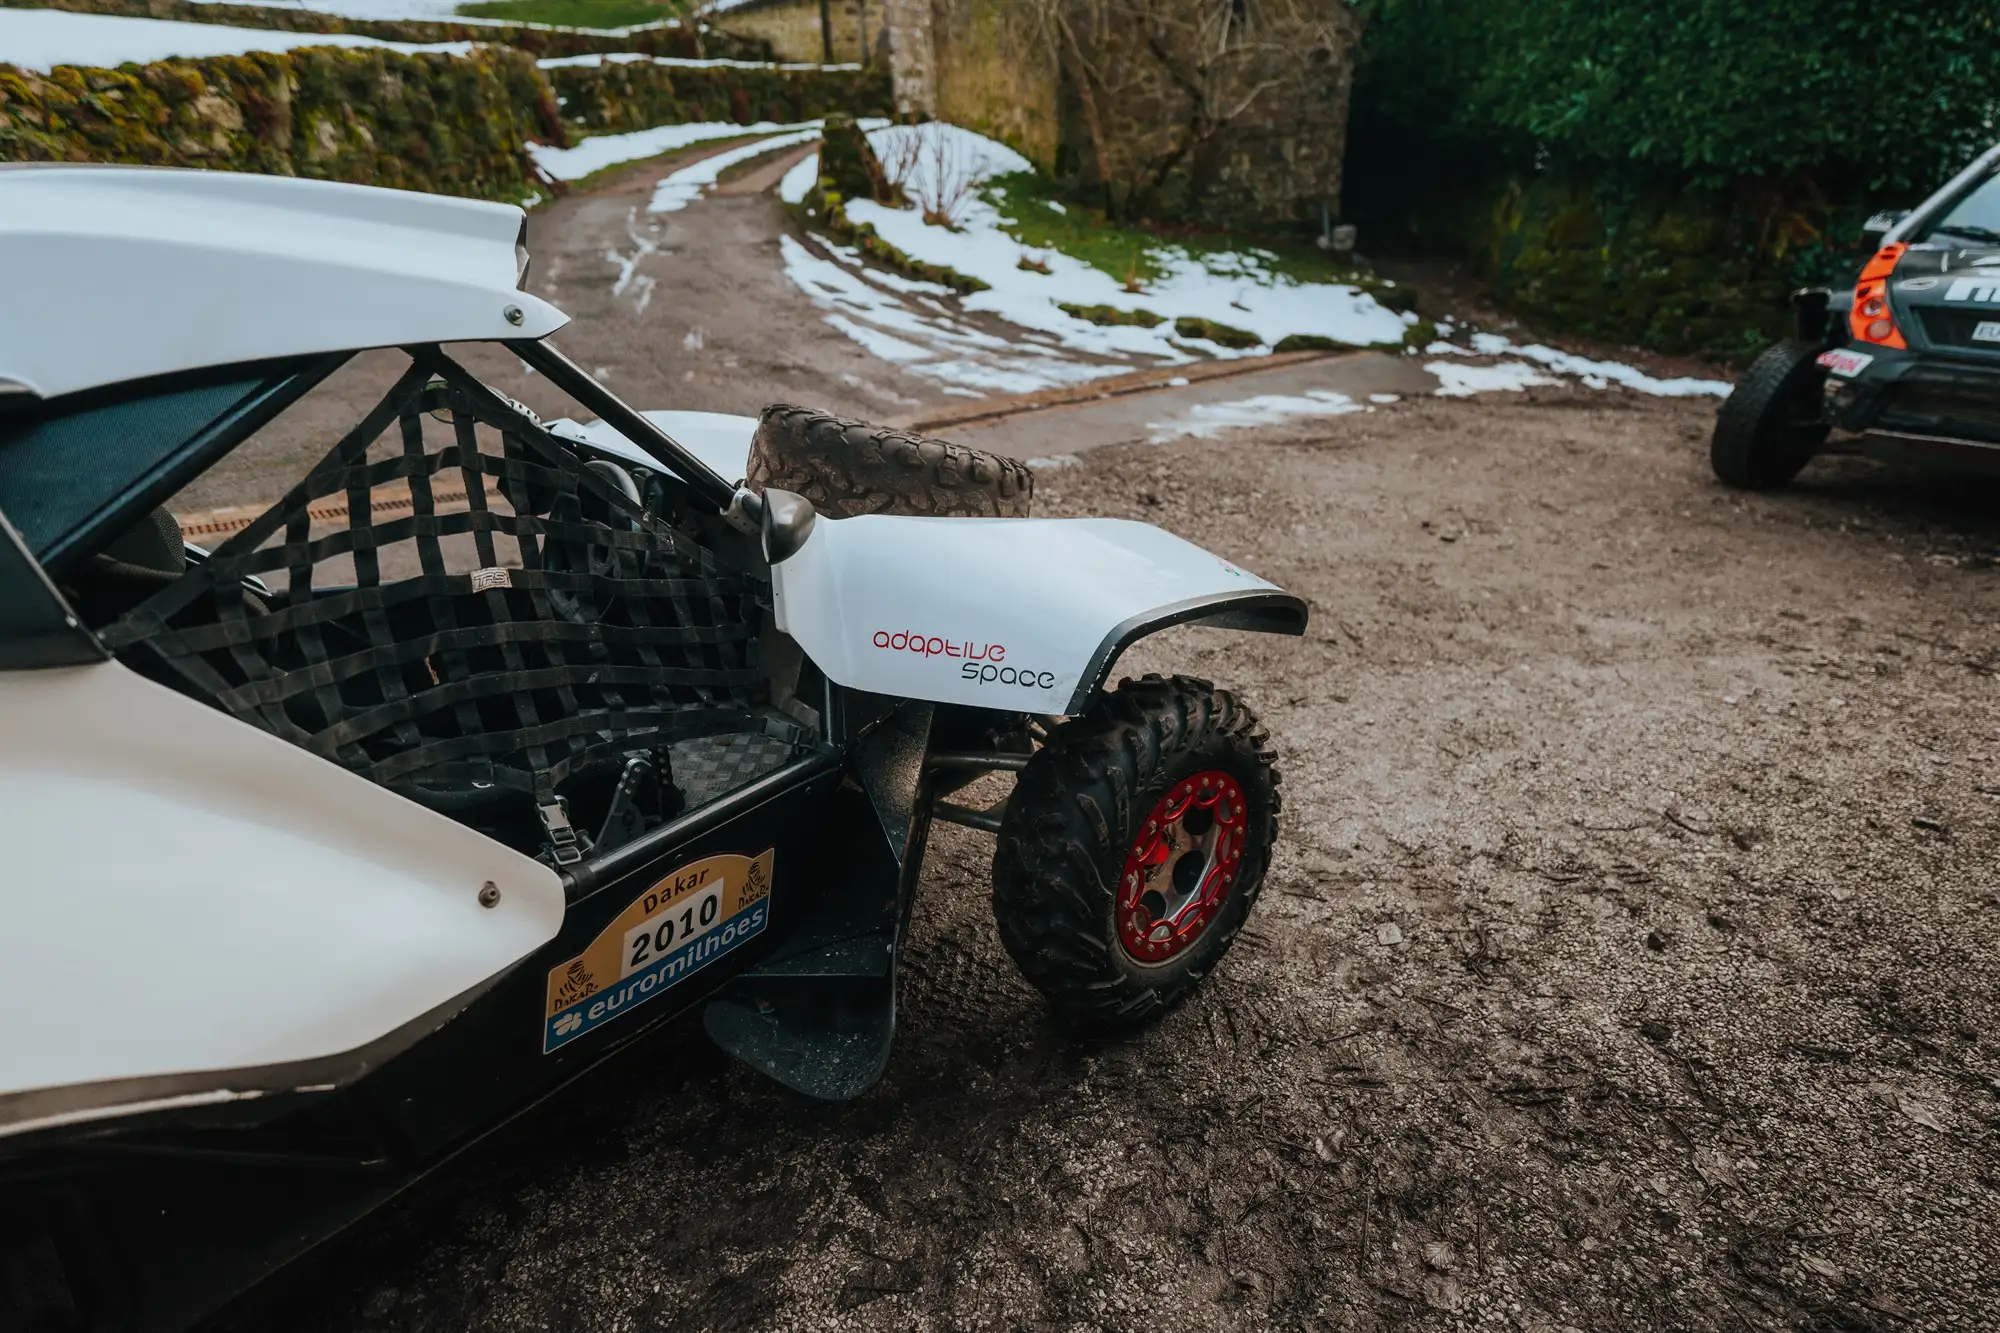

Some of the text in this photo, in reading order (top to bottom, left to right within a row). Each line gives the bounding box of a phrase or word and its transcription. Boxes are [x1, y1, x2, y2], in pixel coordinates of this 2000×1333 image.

[873, 630, 1005, 662] adaptive
[961, 662, 1055, 689] space
[643, 868, 709, 914] Dakar
[630, 894, 718, 968] 2010
[588, 908, 763, 1020] euromilhões
